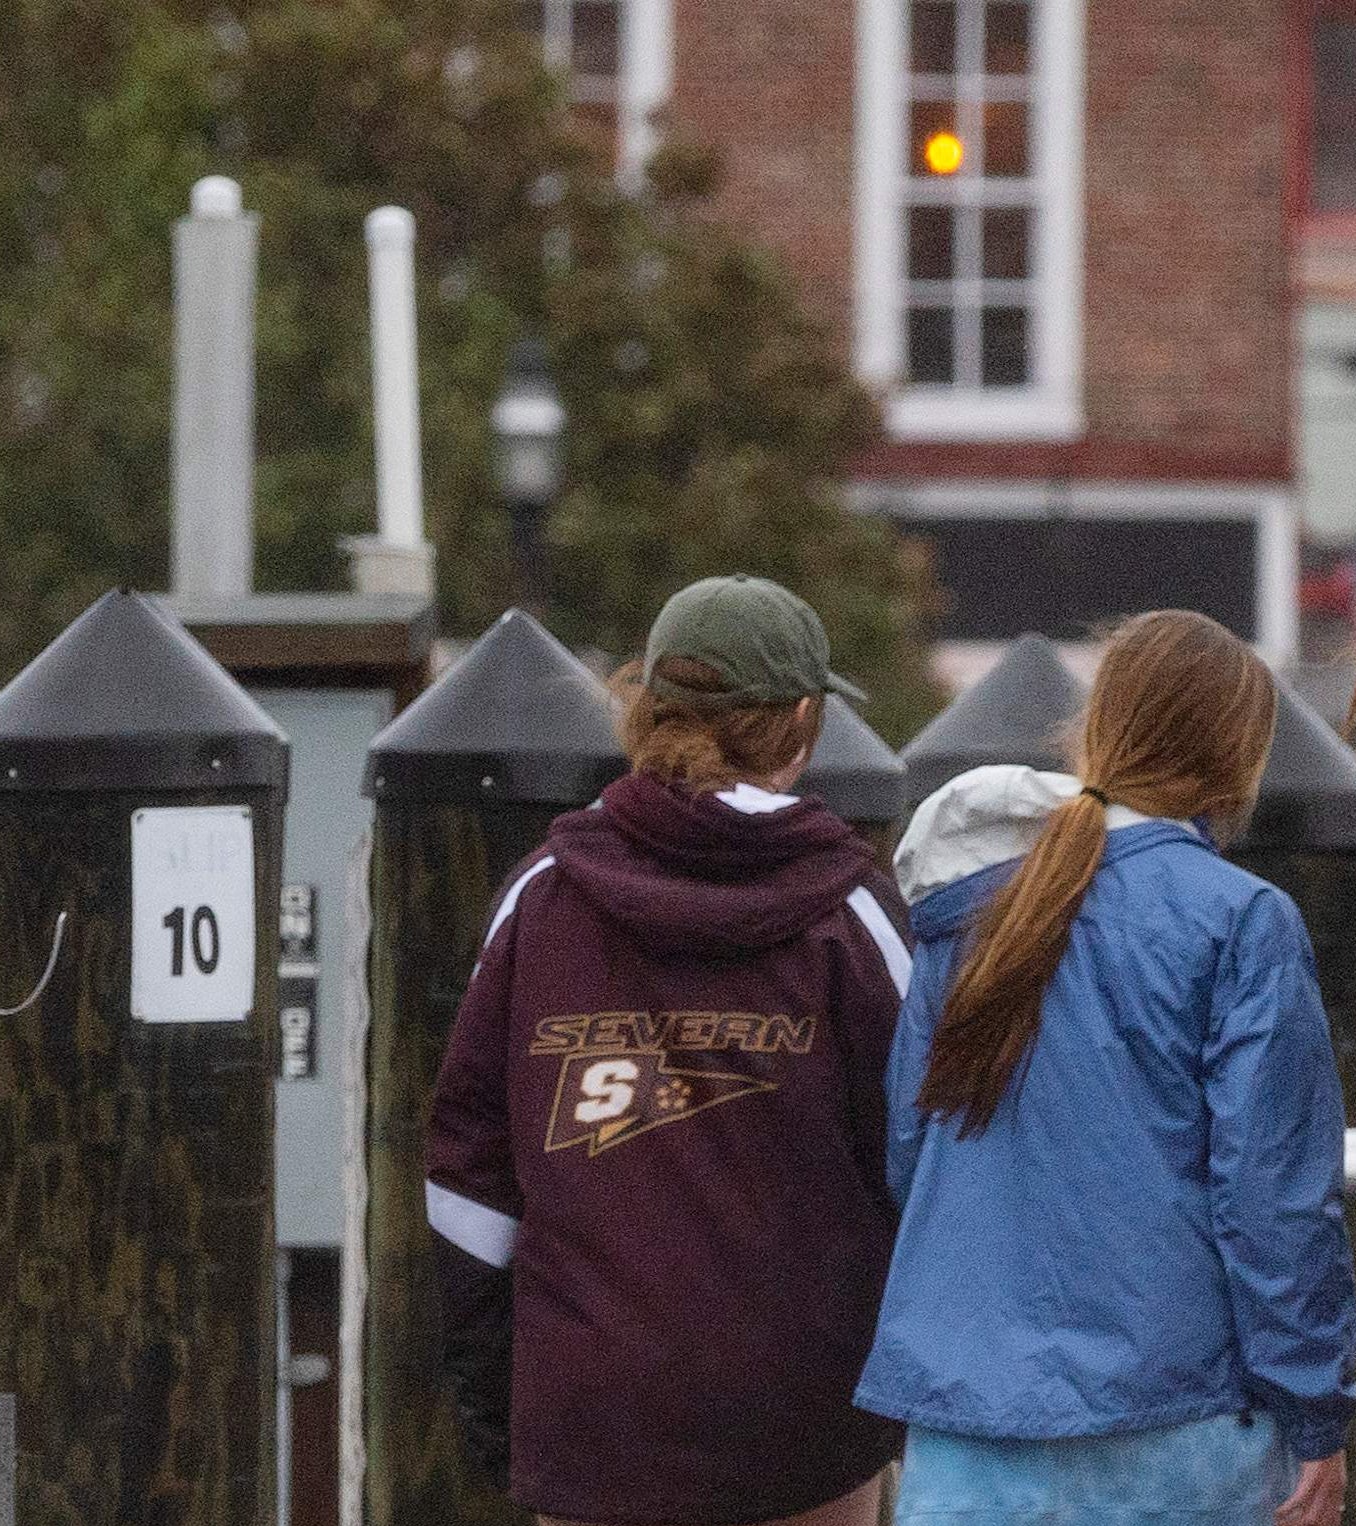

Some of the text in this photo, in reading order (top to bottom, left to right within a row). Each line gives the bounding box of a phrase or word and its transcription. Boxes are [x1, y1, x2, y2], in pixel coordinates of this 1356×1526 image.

[163, 906, 219, 976] 10
[530, 1010, 816, 1055] SEVERN
[574, 1059, 639, 1122] S
